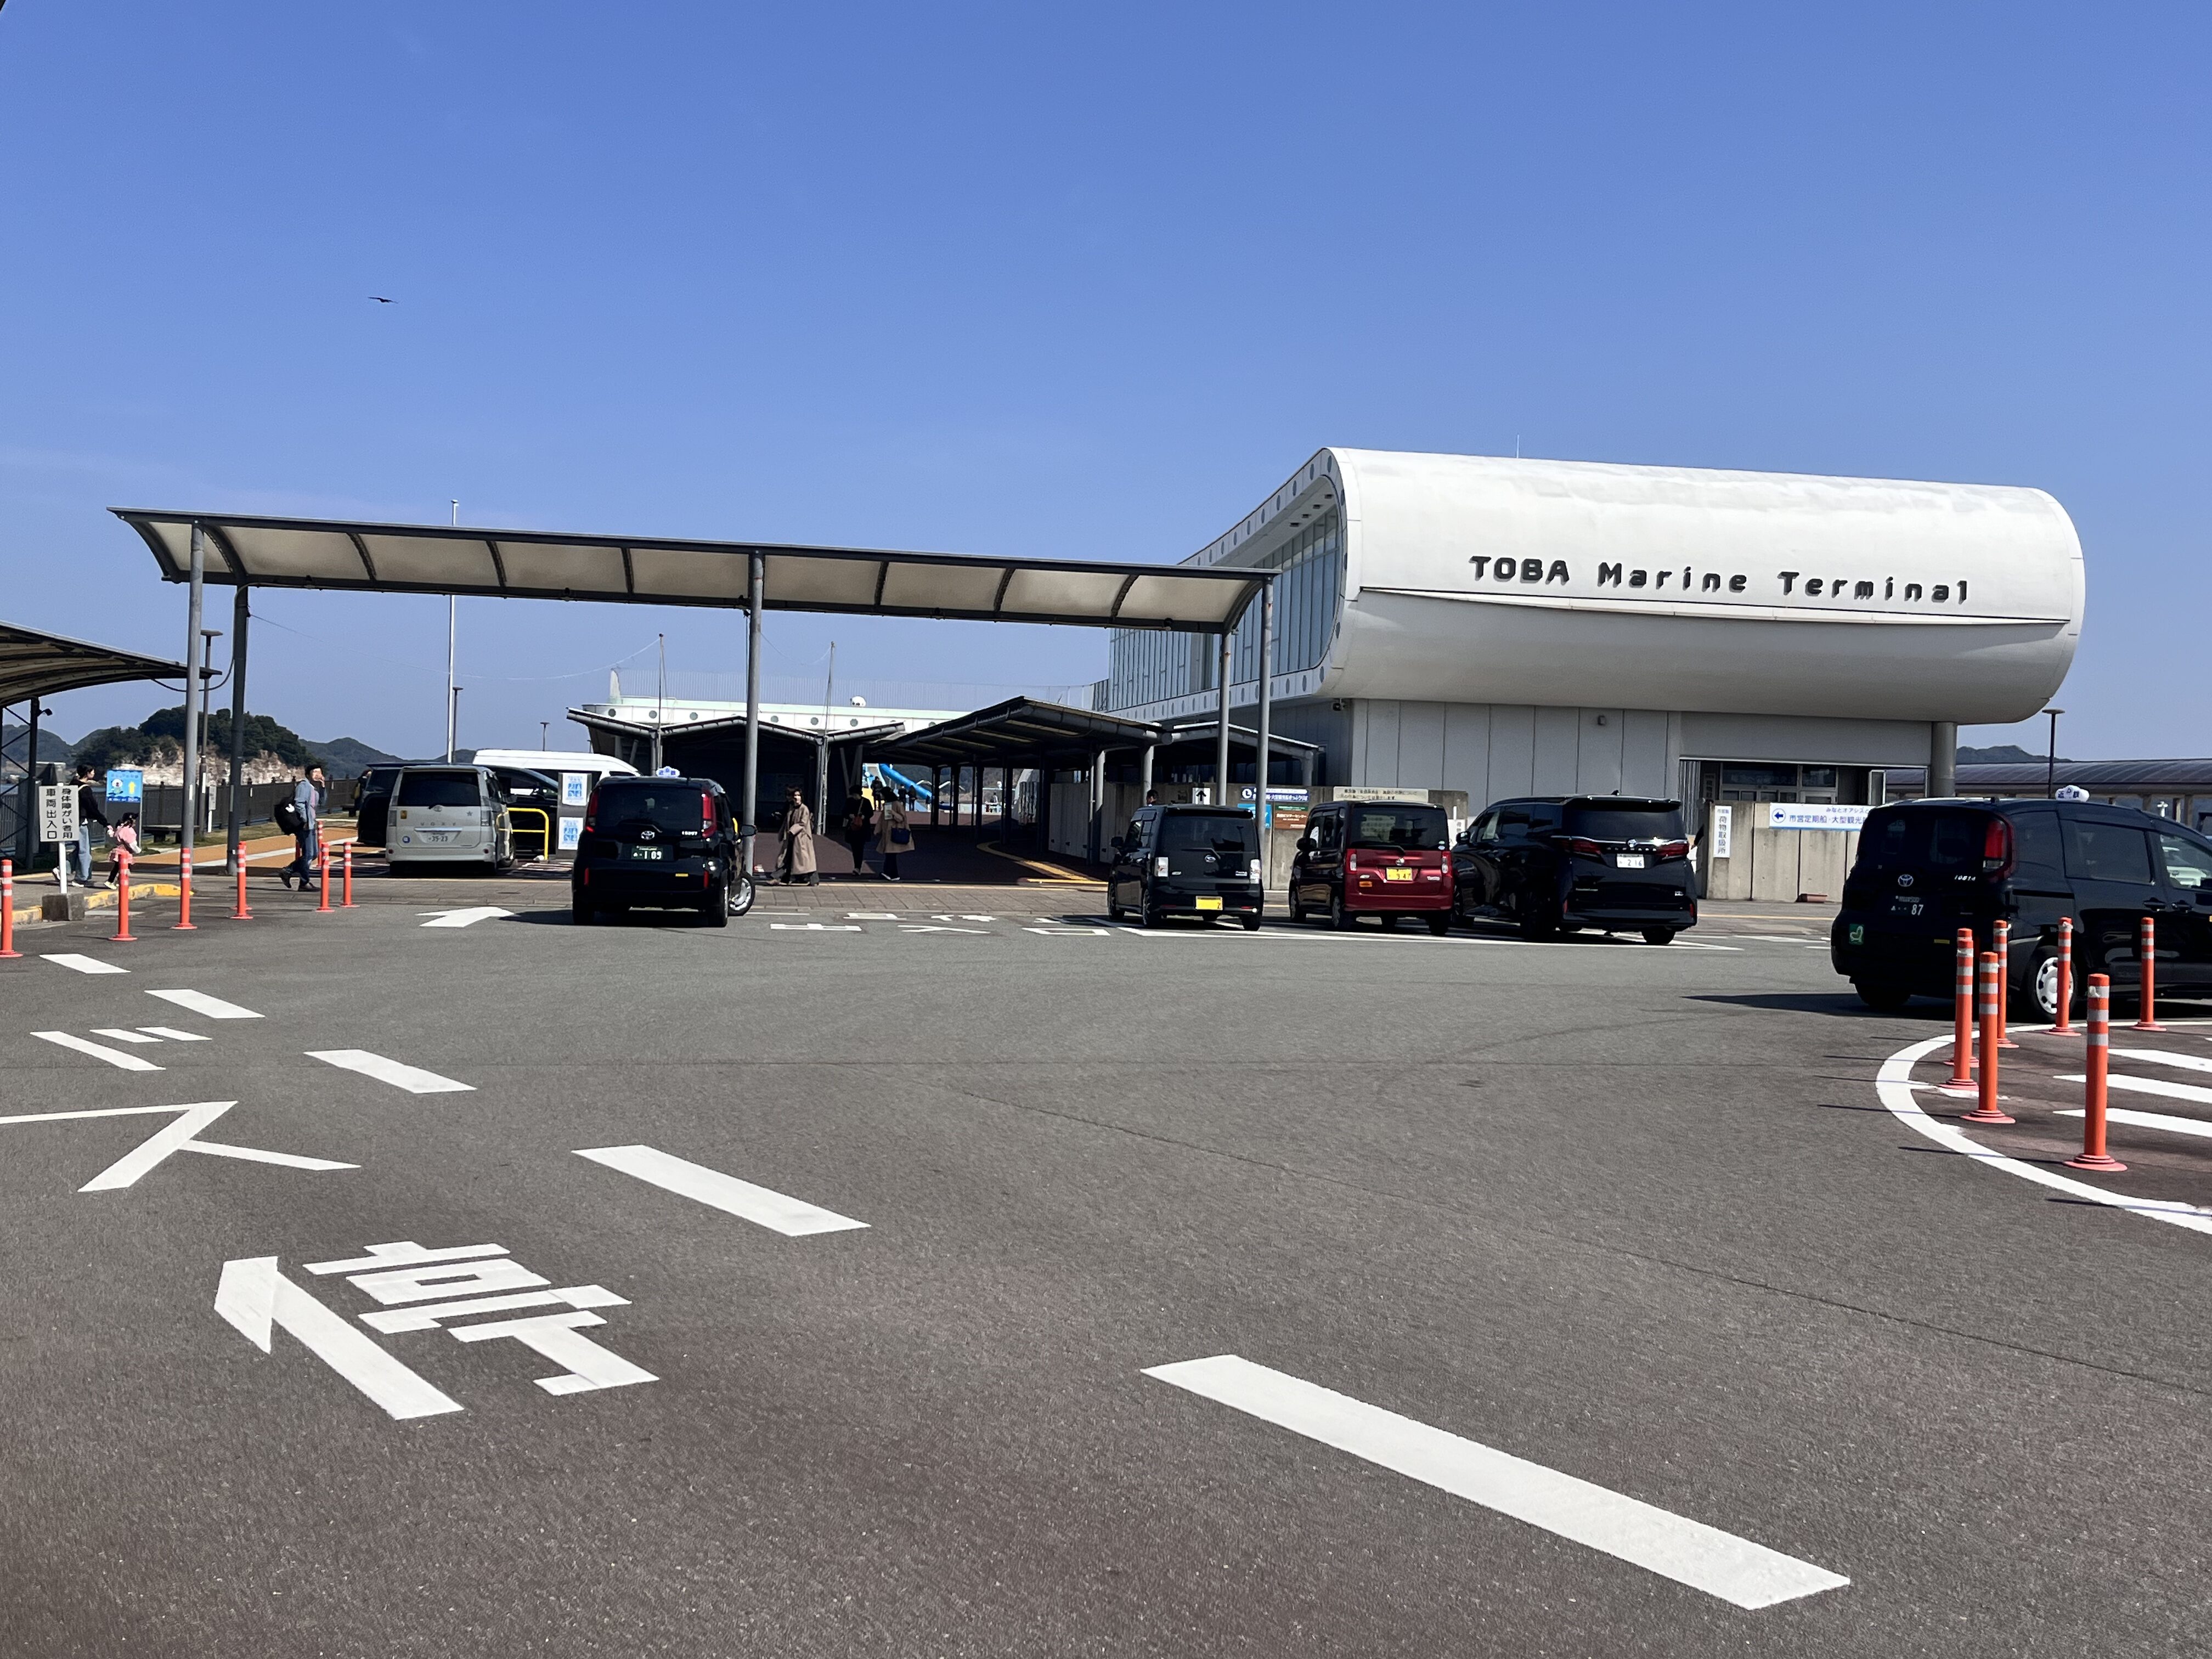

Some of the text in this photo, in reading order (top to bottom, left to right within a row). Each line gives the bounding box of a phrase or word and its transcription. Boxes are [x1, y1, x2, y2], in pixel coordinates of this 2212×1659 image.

[1469, 556, 1967, 605] TOBA Marine Terminal
[46, 788, 57, 839] 車両出入口
[61, 788, 72, 839] 身体障がい者用
[1911, 904, 1924, 916] 87
